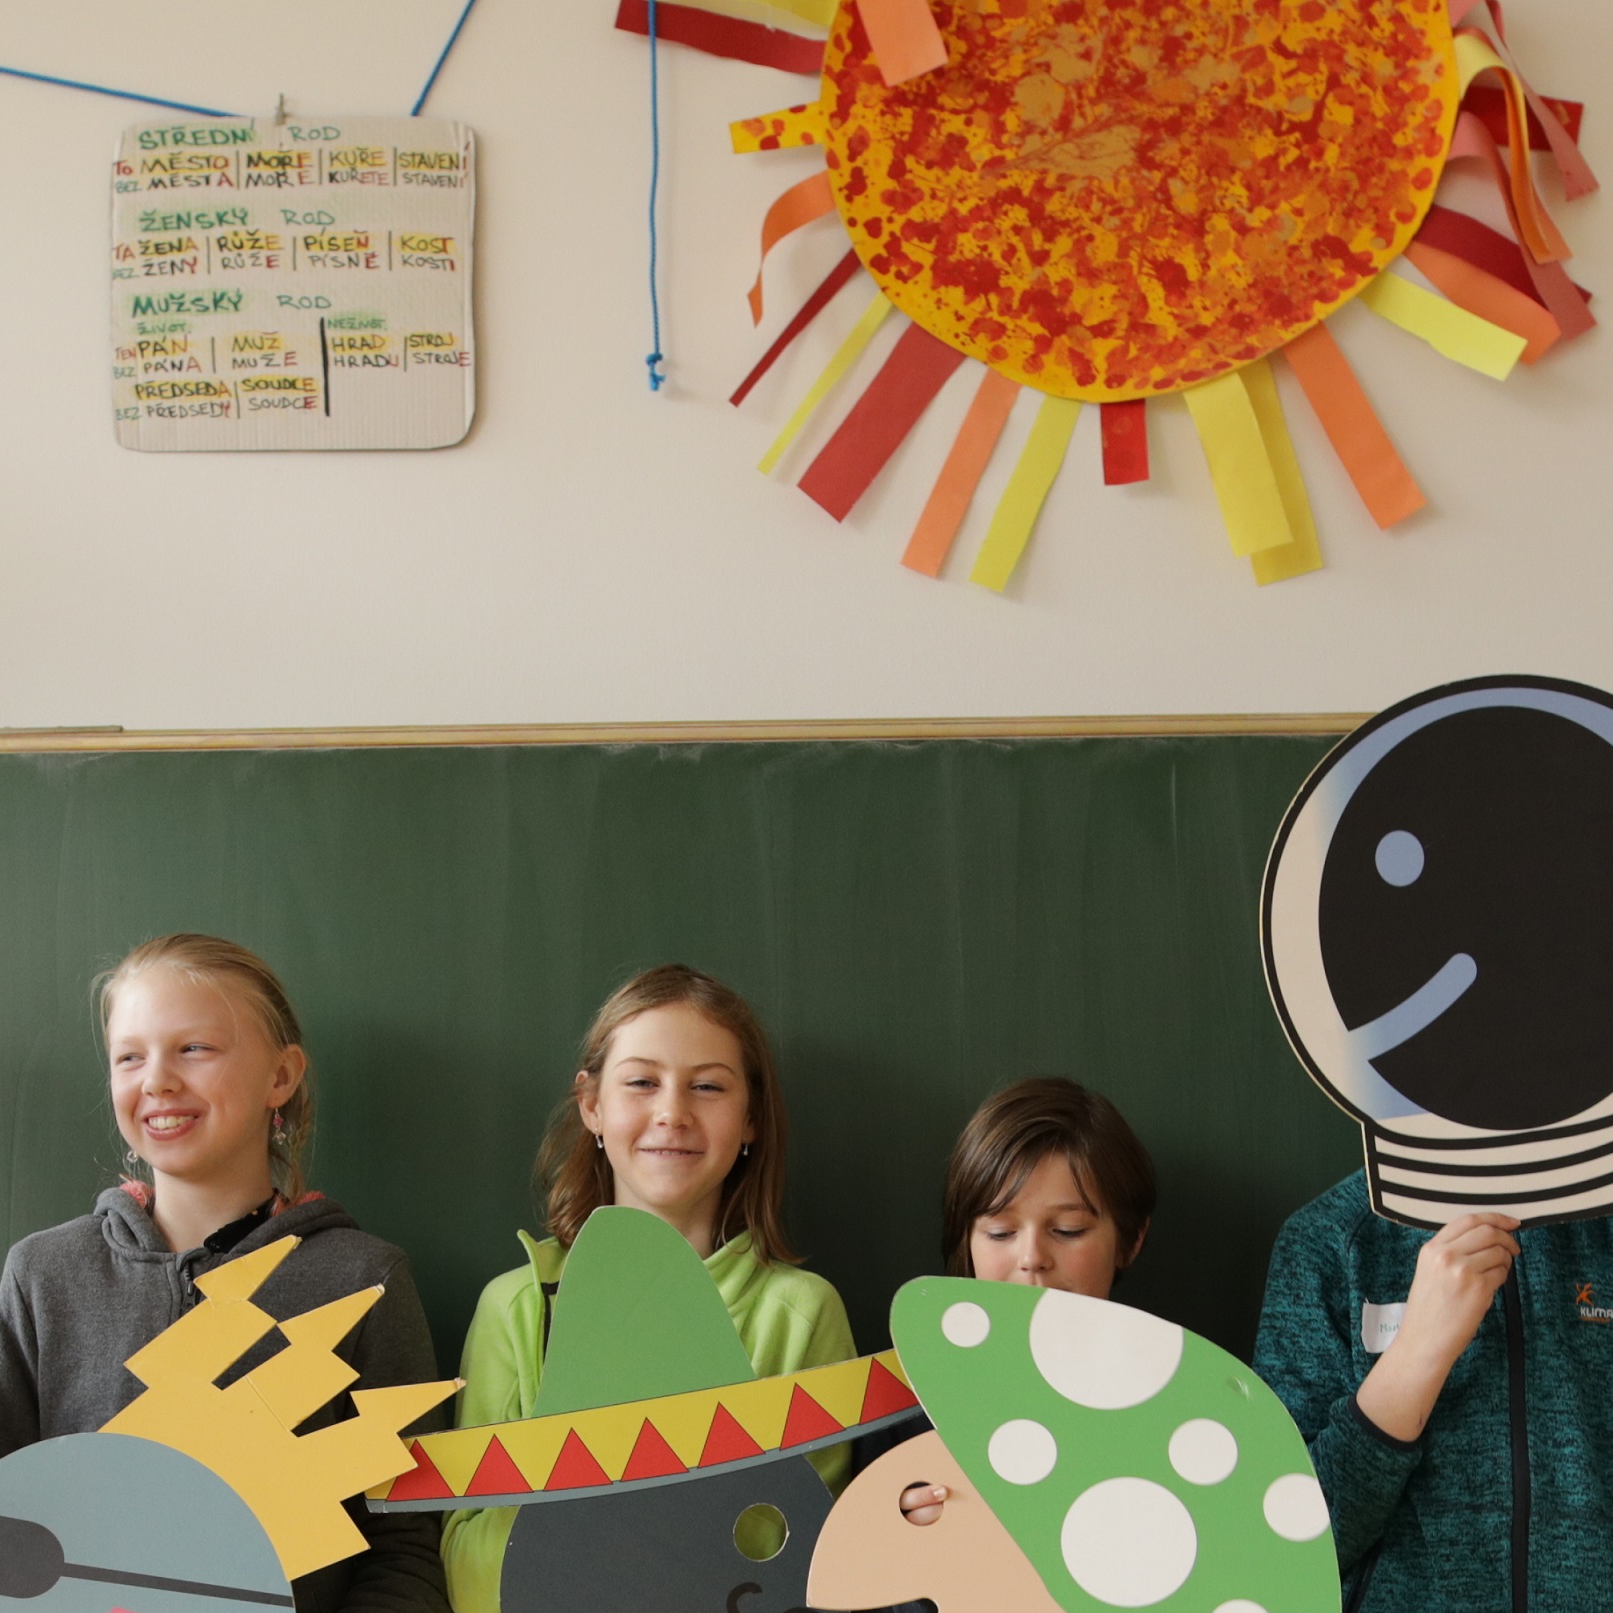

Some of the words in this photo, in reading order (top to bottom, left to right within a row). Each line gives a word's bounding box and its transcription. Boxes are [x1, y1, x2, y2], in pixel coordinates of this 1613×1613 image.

[139, 118, 255, 149] STŘEDNÍ
[288, 126, 340, 141] ROD
[114, 160, 133, 175] TO
[140, 151, 229, 174] MĚSTO
[247, 150, 313, 170] MOŘE
[330, 146, 386, 167] KUŘE
[399, 141, 470, 170] STAVENÍ
[115, 180, 143, 193] BEZ
[147, 173, 234, 191] MĚSTA
[246, 171, 314, 187] MOŘE
[329, 167, 389, 186] KUŘETE
[403, 171, 468, 188] STAVENÍ
[139, 208, 248, 231] ŽENSKÝ
[280, 208, 335, 226] ROD
[113, 243, 135, 261] TA
[138, 237, 198, 255] ŽENA
[217, 229, 283, 251] RŮŽE
[303, 227, 369, 252] PÍSEŇ
[400, 236, 454, 254] KOST
[143, 256, 197, 277] ŽENY
[222, 252, 281, 269] RŮŽE
[309, 251, 380, 269] PÍSNĚ
[402, 254, 455, 271] KOSTI
[132, 290, 242, 317] MUŽSKÝ
[276, 295, 332, 309] ROD
[115, 347, 136, 360] TEN
[138, 336, 187, 359] PÁN
[232, 331, 281, 352] MUŽ
[332, 334, 386, 352] HRAD
[409, 332, 454, 348] STROJ
[113, 366, 136, 379] BEZ
[144, 356, 202, 374] PÁNA
[232, 351, 298, 370] MUŽE
[334, 354, 399, 367] HRADU
[413, 352, 472, 367] STROJE
[134, 380, 232, 399] PŘEDSEDA
[242, 377, 317, 393] SOUDCE
[116, 407, 141, 421] BEZ
[146, 401, 230, 419] PŘEDSEDY
[248, 396, 317, 411] SOUDCE
